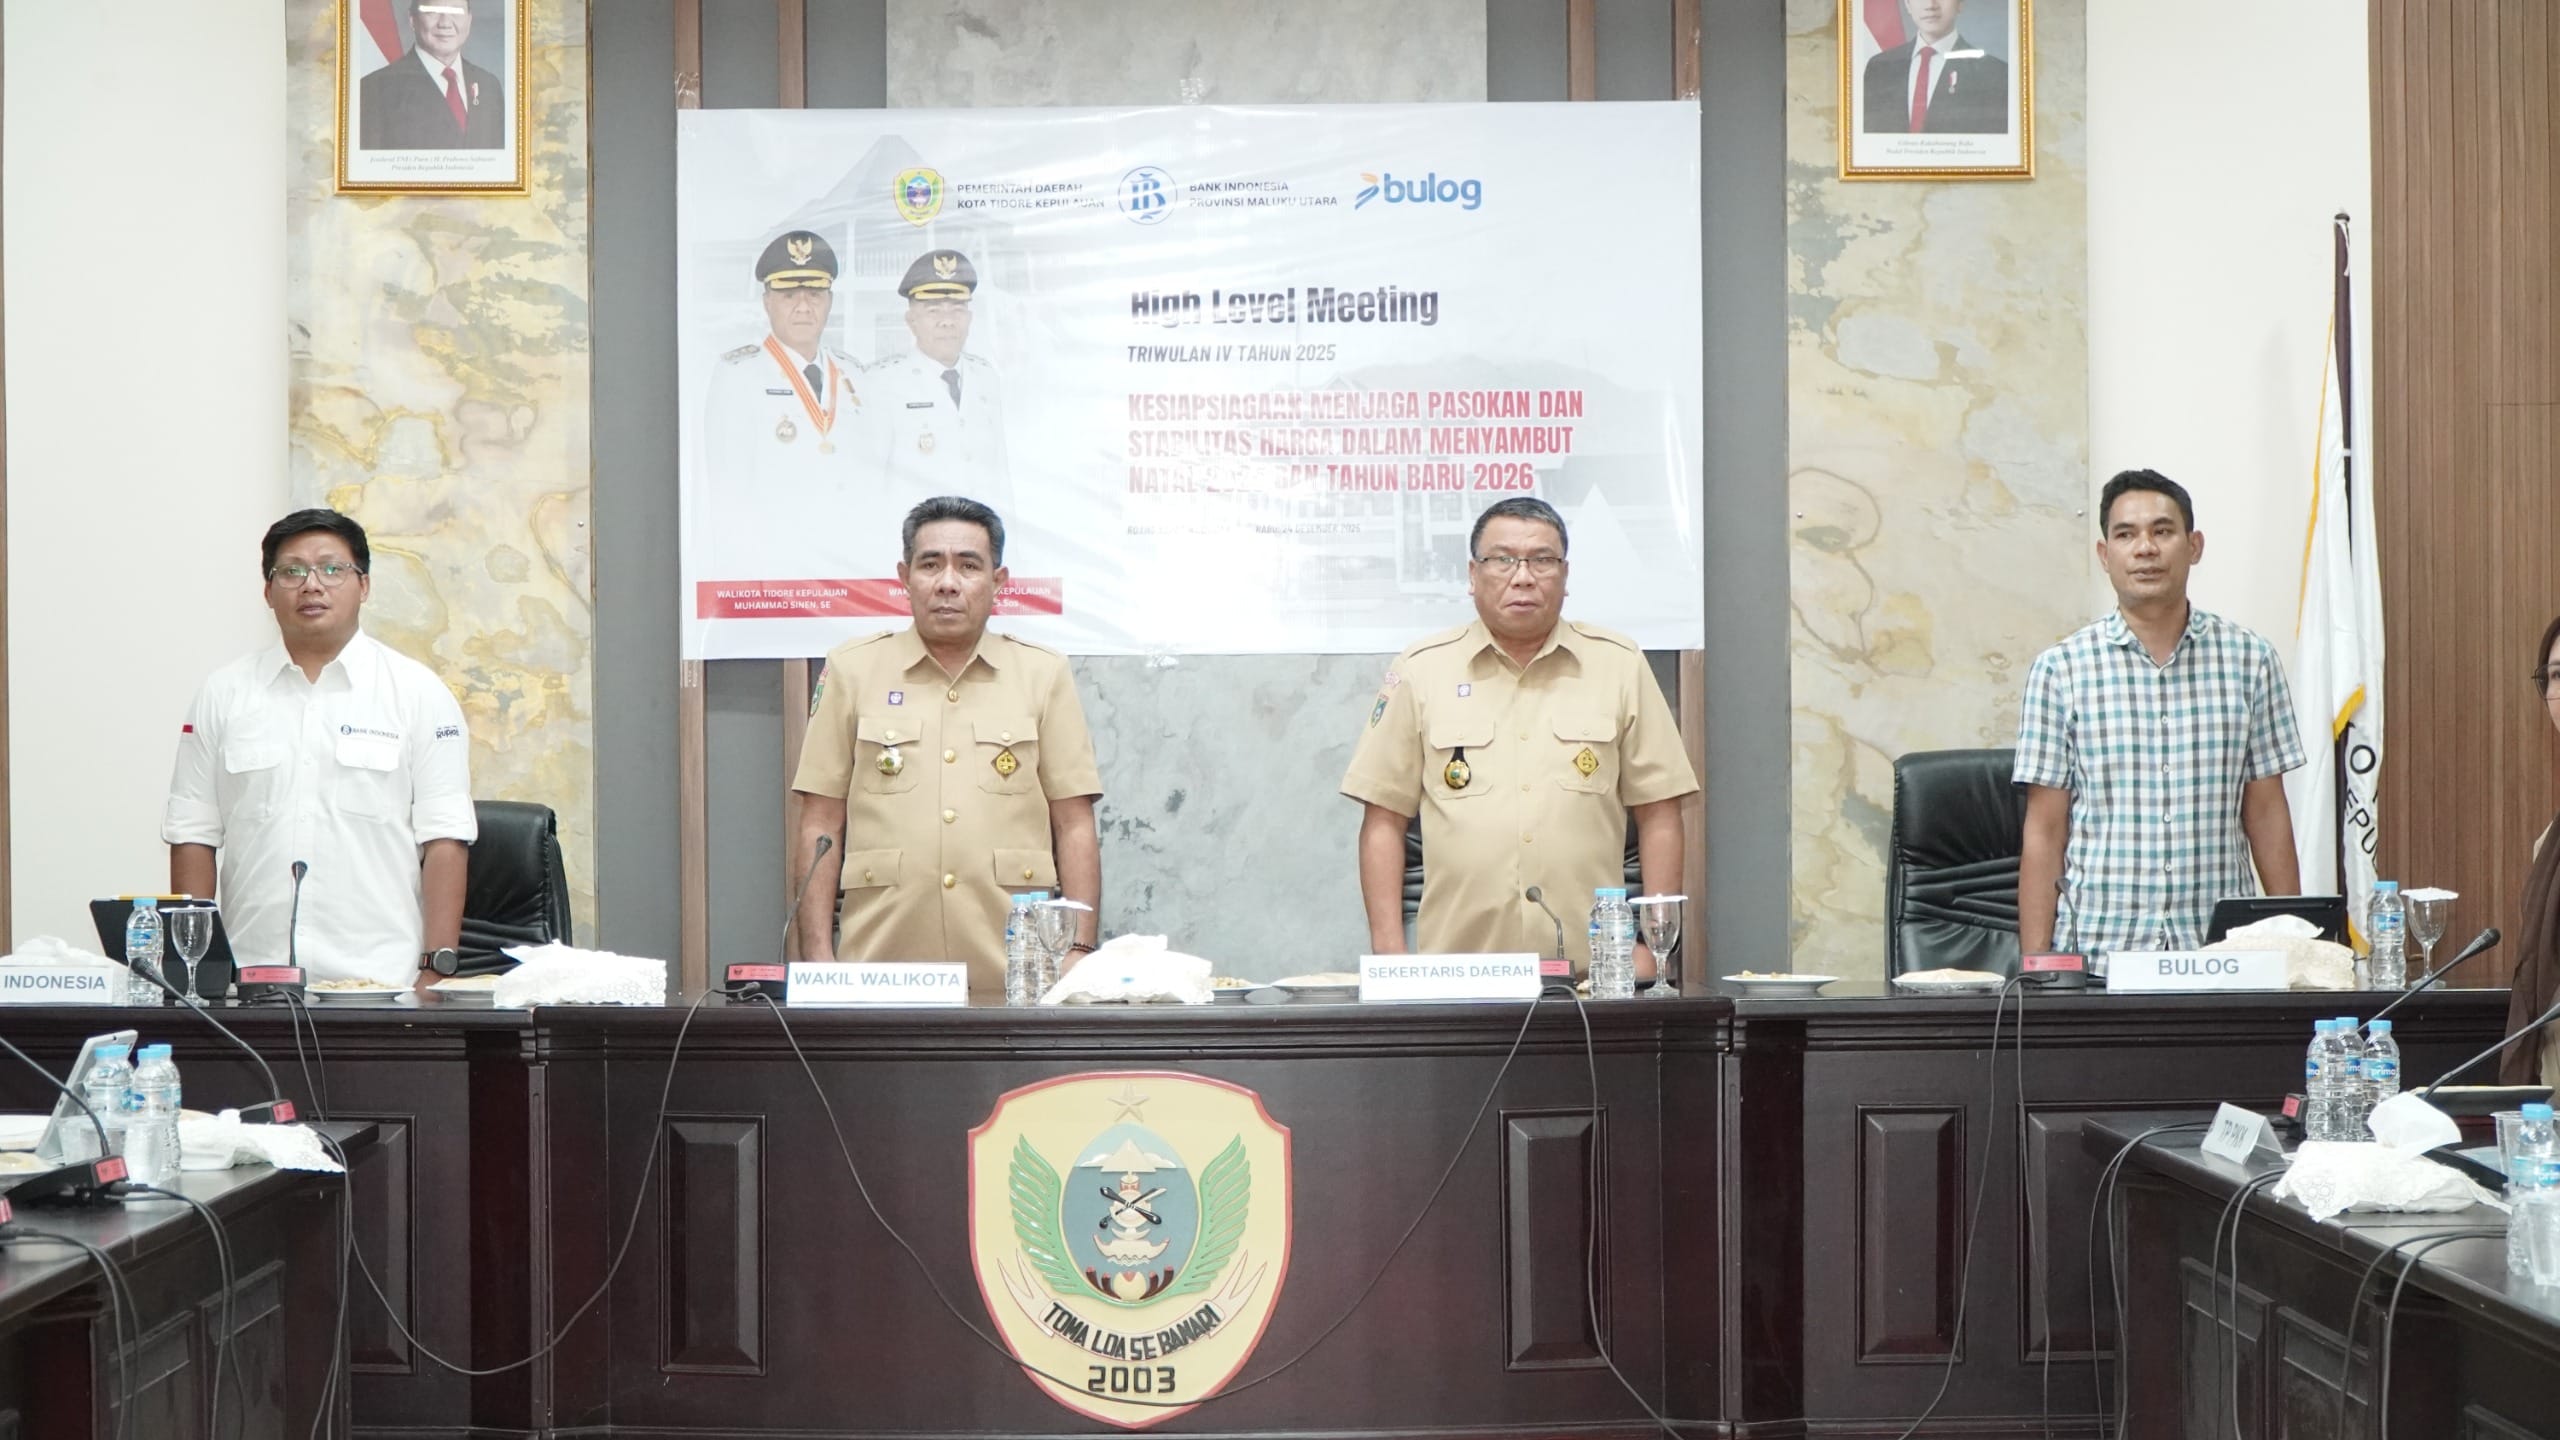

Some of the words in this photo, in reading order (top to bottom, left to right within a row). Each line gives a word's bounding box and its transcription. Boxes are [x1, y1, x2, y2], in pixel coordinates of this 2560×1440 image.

[957, 184, 1032, 193] PEMERINTAH
[1035, 184, 1083, 193] DAERAH
[1189, 182, 1222, 192] BANK
[1224, 182, 1289, 192] INDONESIA
[1384, 172, 1482, 210] bulog
[957, 199, 986, 209] KOTA
[989, 199, 1033, 209] TIDORE
[1189, 197, 1245, 207] PROVINSI
[1247, 197, 1297, 207] MALUKU
[1299, 196, 1338, 206] UTARA
[1131, 289, 1201, 328] High
[1212, 288, 1296, 324] Level
[1307, 285, 1438, 326] Meeting
[1127, 345, 1212, 362] TRIWULAN
[1216, 345, 1233, 362] IV
[1238, 344, 1292, 361] TAHUN
[1295, 344, 1337, 361] 2025
[1128, 393, 1302, 421] KESIAPSIAGAAN
[1310, 391, 1420, 419] MENJAGA
[1428, 391, 1530, 418] PASOKAN
[1539, 390, 1583, 418] DAN
[1260, 428, 1334, 456] HARGA
[1342, 427, 1422, 455] DALAM
[1430, 426, 1574, 454] MENYAMBUT
[1327, 463, 1399, 491] TAHUN
[1407, 463, 1465, 491] BARU
[1473, 462, 1534, 490] 2026
[716, 589, 761, 598] WALIKOTA
[762, 589, 793, 598] TIDORE
[796, 588, 848, 597] KEPULAUAN
[888, 587, 908, 597] WAK
[734, 601, 789, 610] MUHAMMAD
[820, 600, 831, 609] SE
[1368, 966, 1465, 979] SEKERTARIS
[1470, 965, 1534, 978] DAERAH
[2158, 957, 2240, 976] BULOG
[4, 974, 106, 990] INDONESIA
[794, 970, 854, 987] WAKIL
[860, 971, 961, 987] WALIKOTA
[1043, 1302, 1090, 1347] TOMA
[1091, 1329, 1126, 1360] LOA
[1130, 1335, 1158, 1361] SE
[1088, 1365, 1176, 1393] 2003
